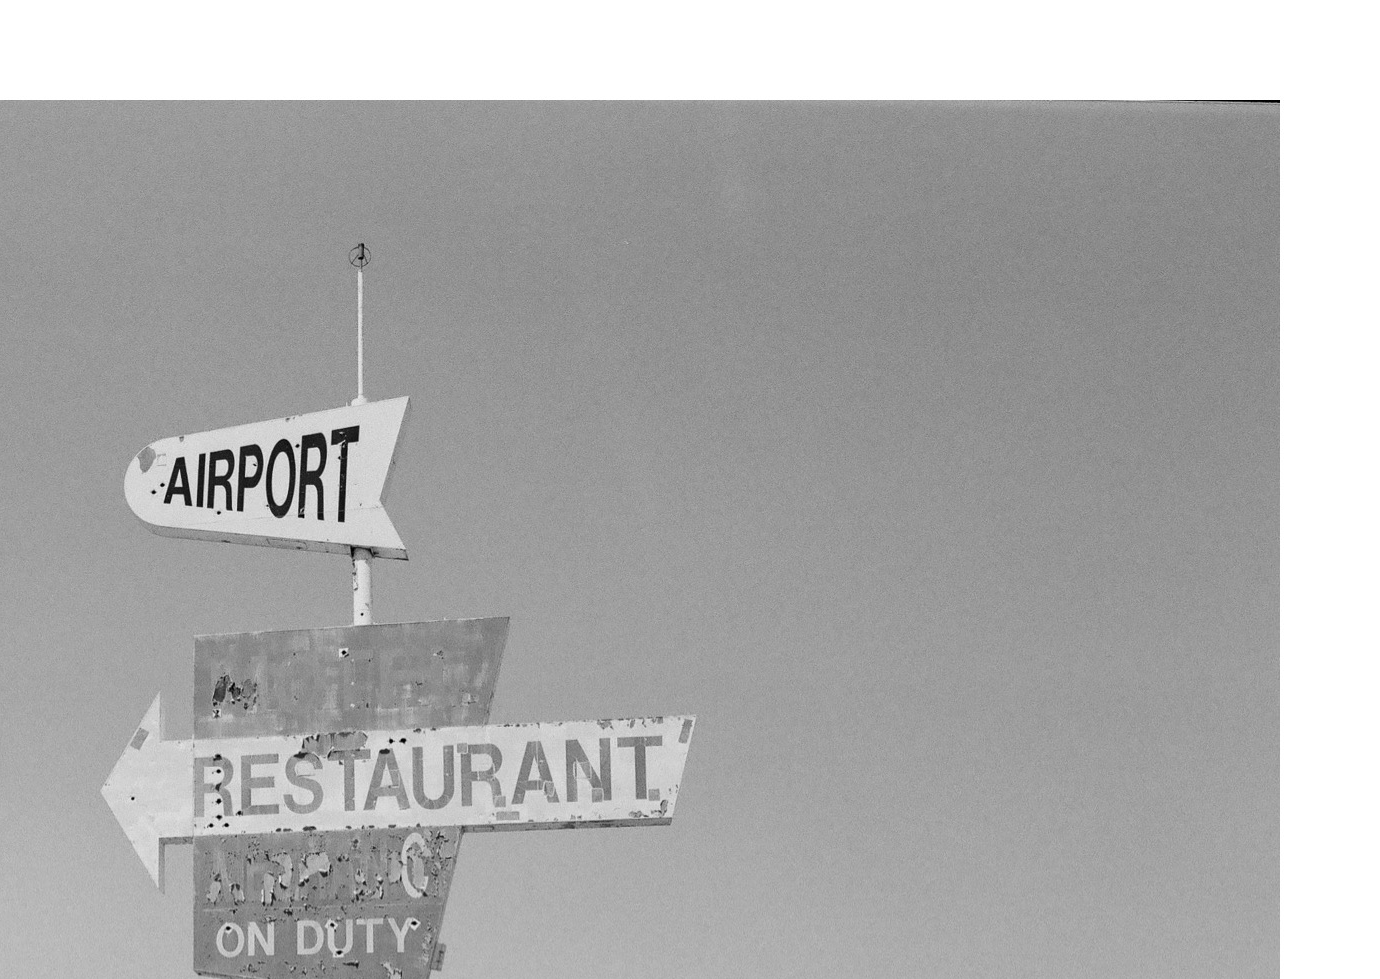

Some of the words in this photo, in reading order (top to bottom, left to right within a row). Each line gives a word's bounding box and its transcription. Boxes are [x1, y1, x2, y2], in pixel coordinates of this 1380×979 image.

[163, 424, 360, 523] AIRPORT
[193, 734, 663, 818] RESTAURANT
[215, 920, 275, 958] ON
[296, 916, 417, 957] DUTY
